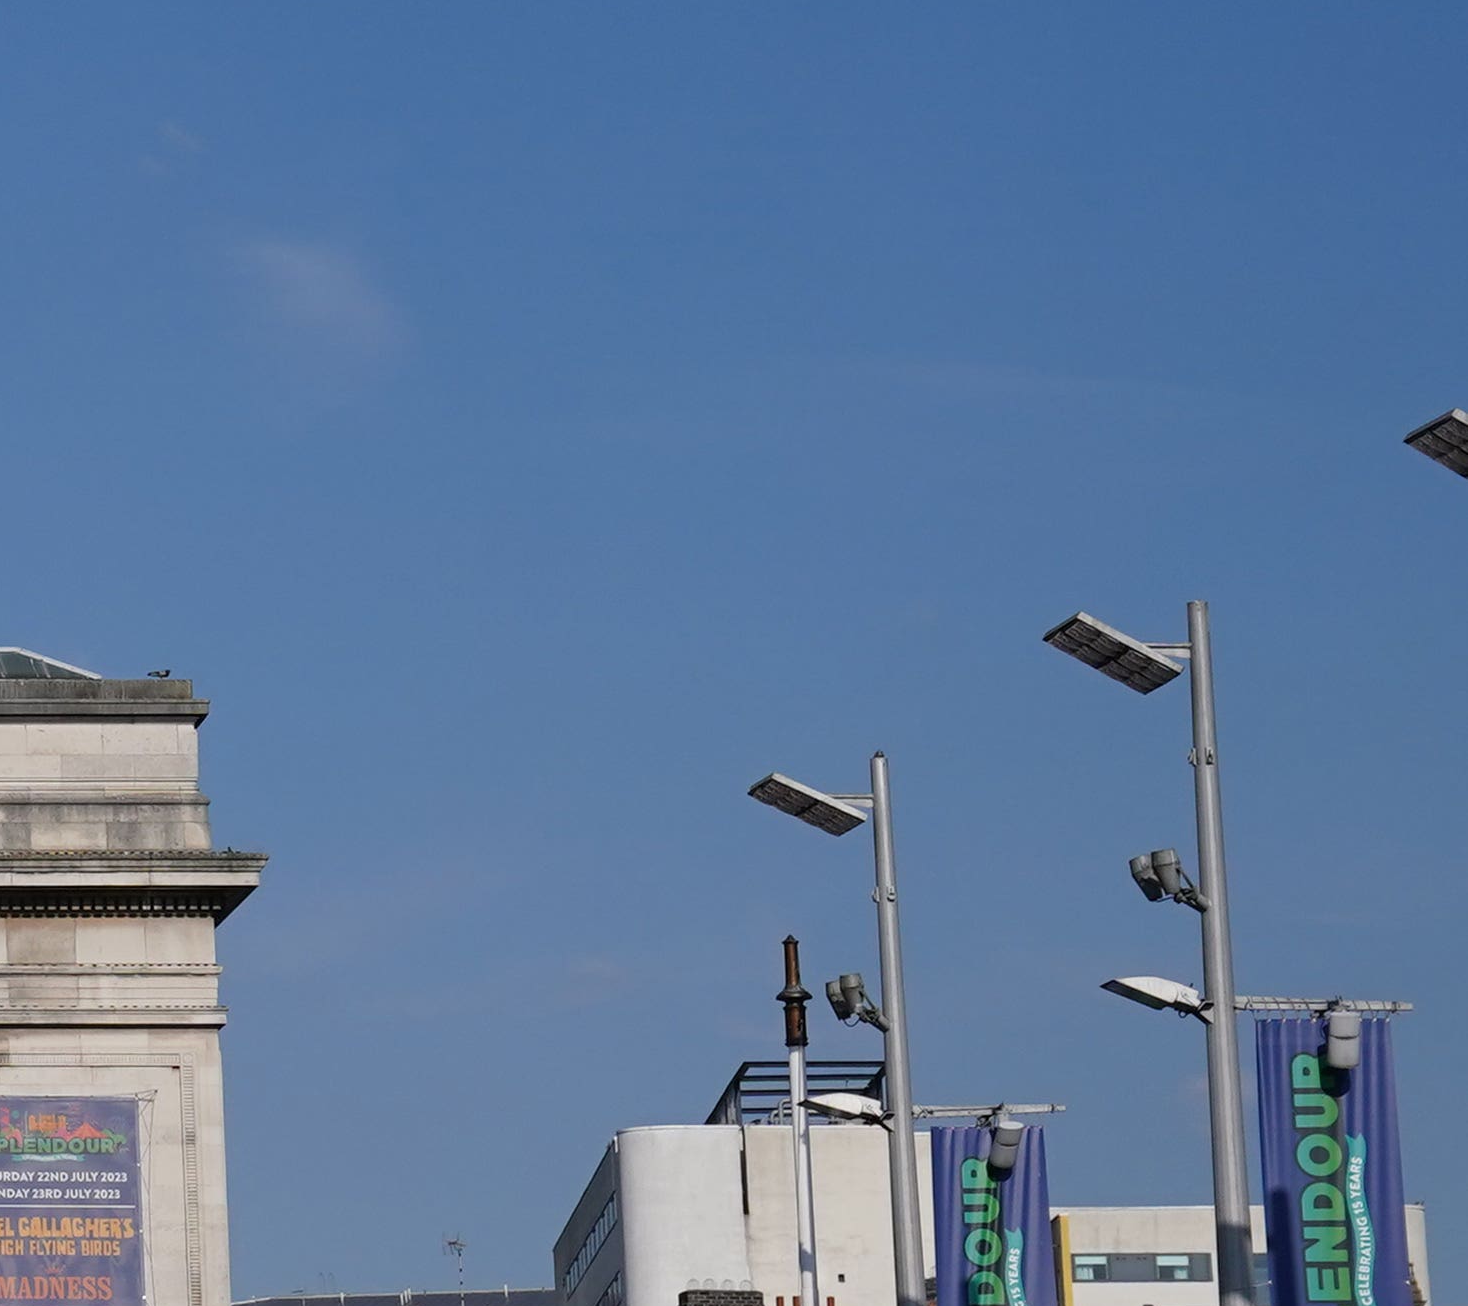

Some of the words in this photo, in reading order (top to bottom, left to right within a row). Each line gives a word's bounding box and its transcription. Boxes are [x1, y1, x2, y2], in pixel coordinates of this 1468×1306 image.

[37, 1172, 69, 1182] 22ND
[70, 1172, 98, 1182] JULY
[100, 1172, 128, 1183] 2023
[1350, 1156, 1365, 1197] YEARS
[32, 1189, 62, 1199] 23RD
[63, 1189, 92, 1199] JULY
[94, 1189, 120, 1199] 2023
[1352, 1198, 1365, 1212] 15
[18, 1217, 135, 1239] GALLAGHER'S
[29, 1239, 75, 1256] FLYING
[82, 1239, 121, 1256] BIRDS
[1007, 1247, 1022, 1281] YEARS
[1358, 1214, 1373, 1306] CELEBRATING
[1012, 1284, 1023, 1297] 15
